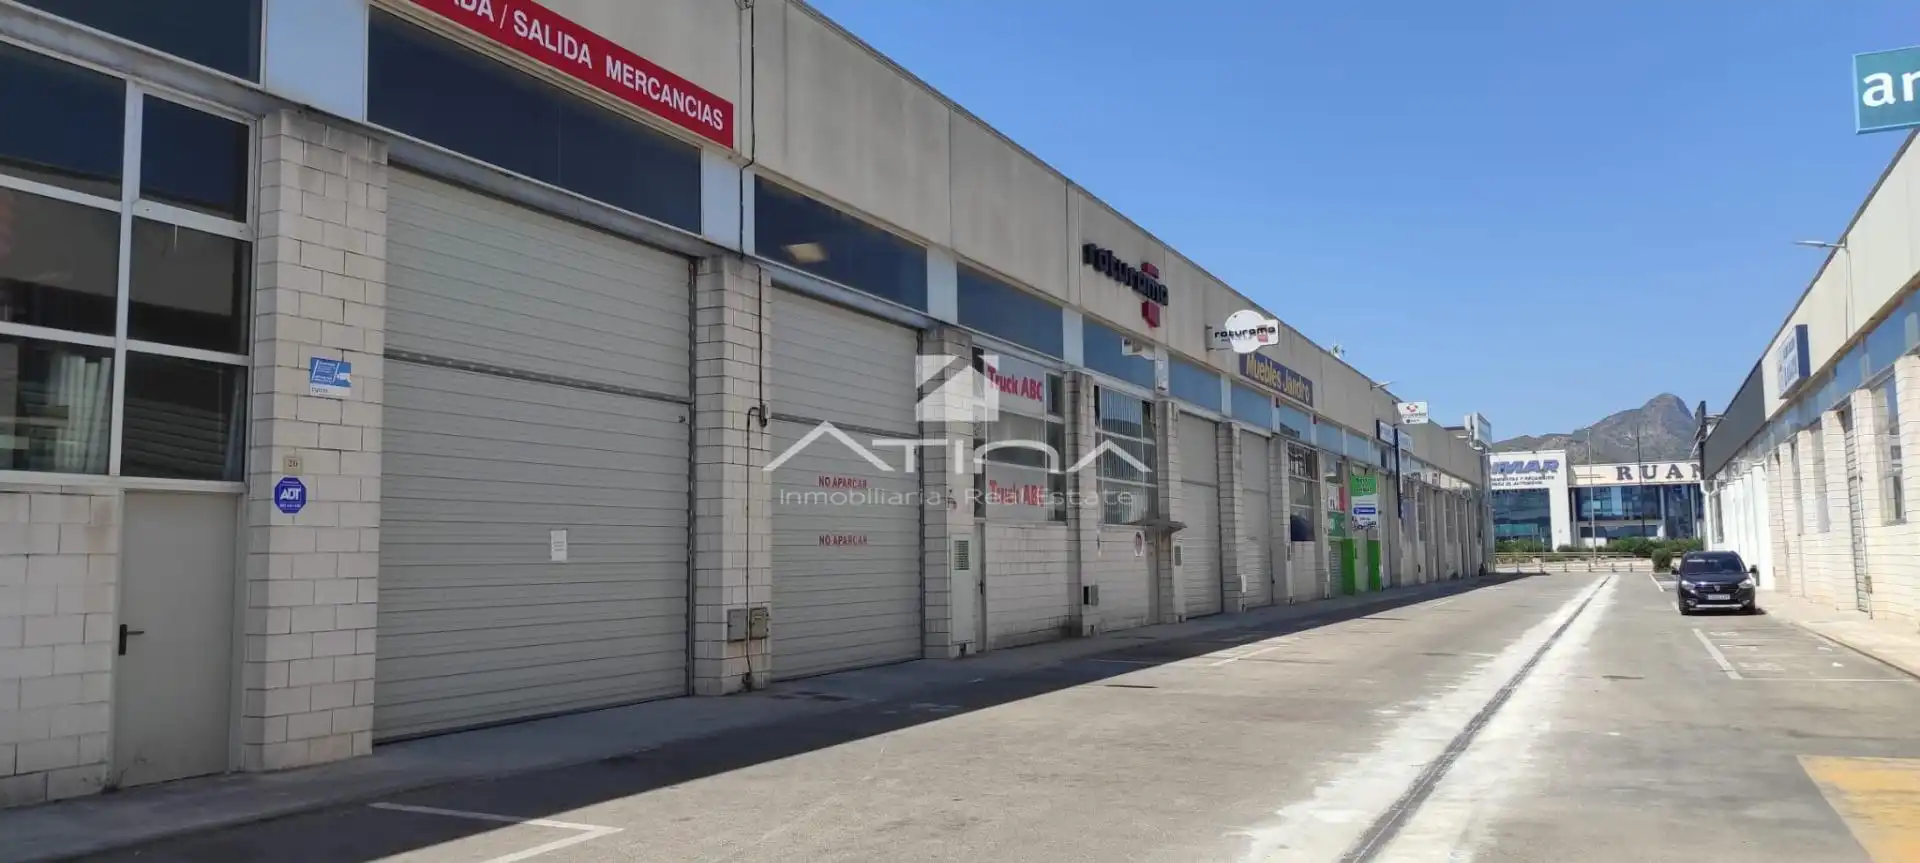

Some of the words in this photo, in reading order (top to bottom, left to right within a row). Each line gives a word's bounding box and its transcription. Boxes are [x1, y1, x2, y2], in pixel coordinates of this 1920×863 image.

[512, 10, 593, 69] SALIDA
[605, 55, 724, 131] MERCANCIAS
[987, 364, 1018, 395] Truck
[1021, 376, 1043, 401] ABC
[1246, 352, 1282, 389] Muebles
[280, 488, 301, 500] ADT
[818, 475, 831, 488] NO
[832, 475, 867, 489] APARCAR
[819, 534, 831, 547] NO
